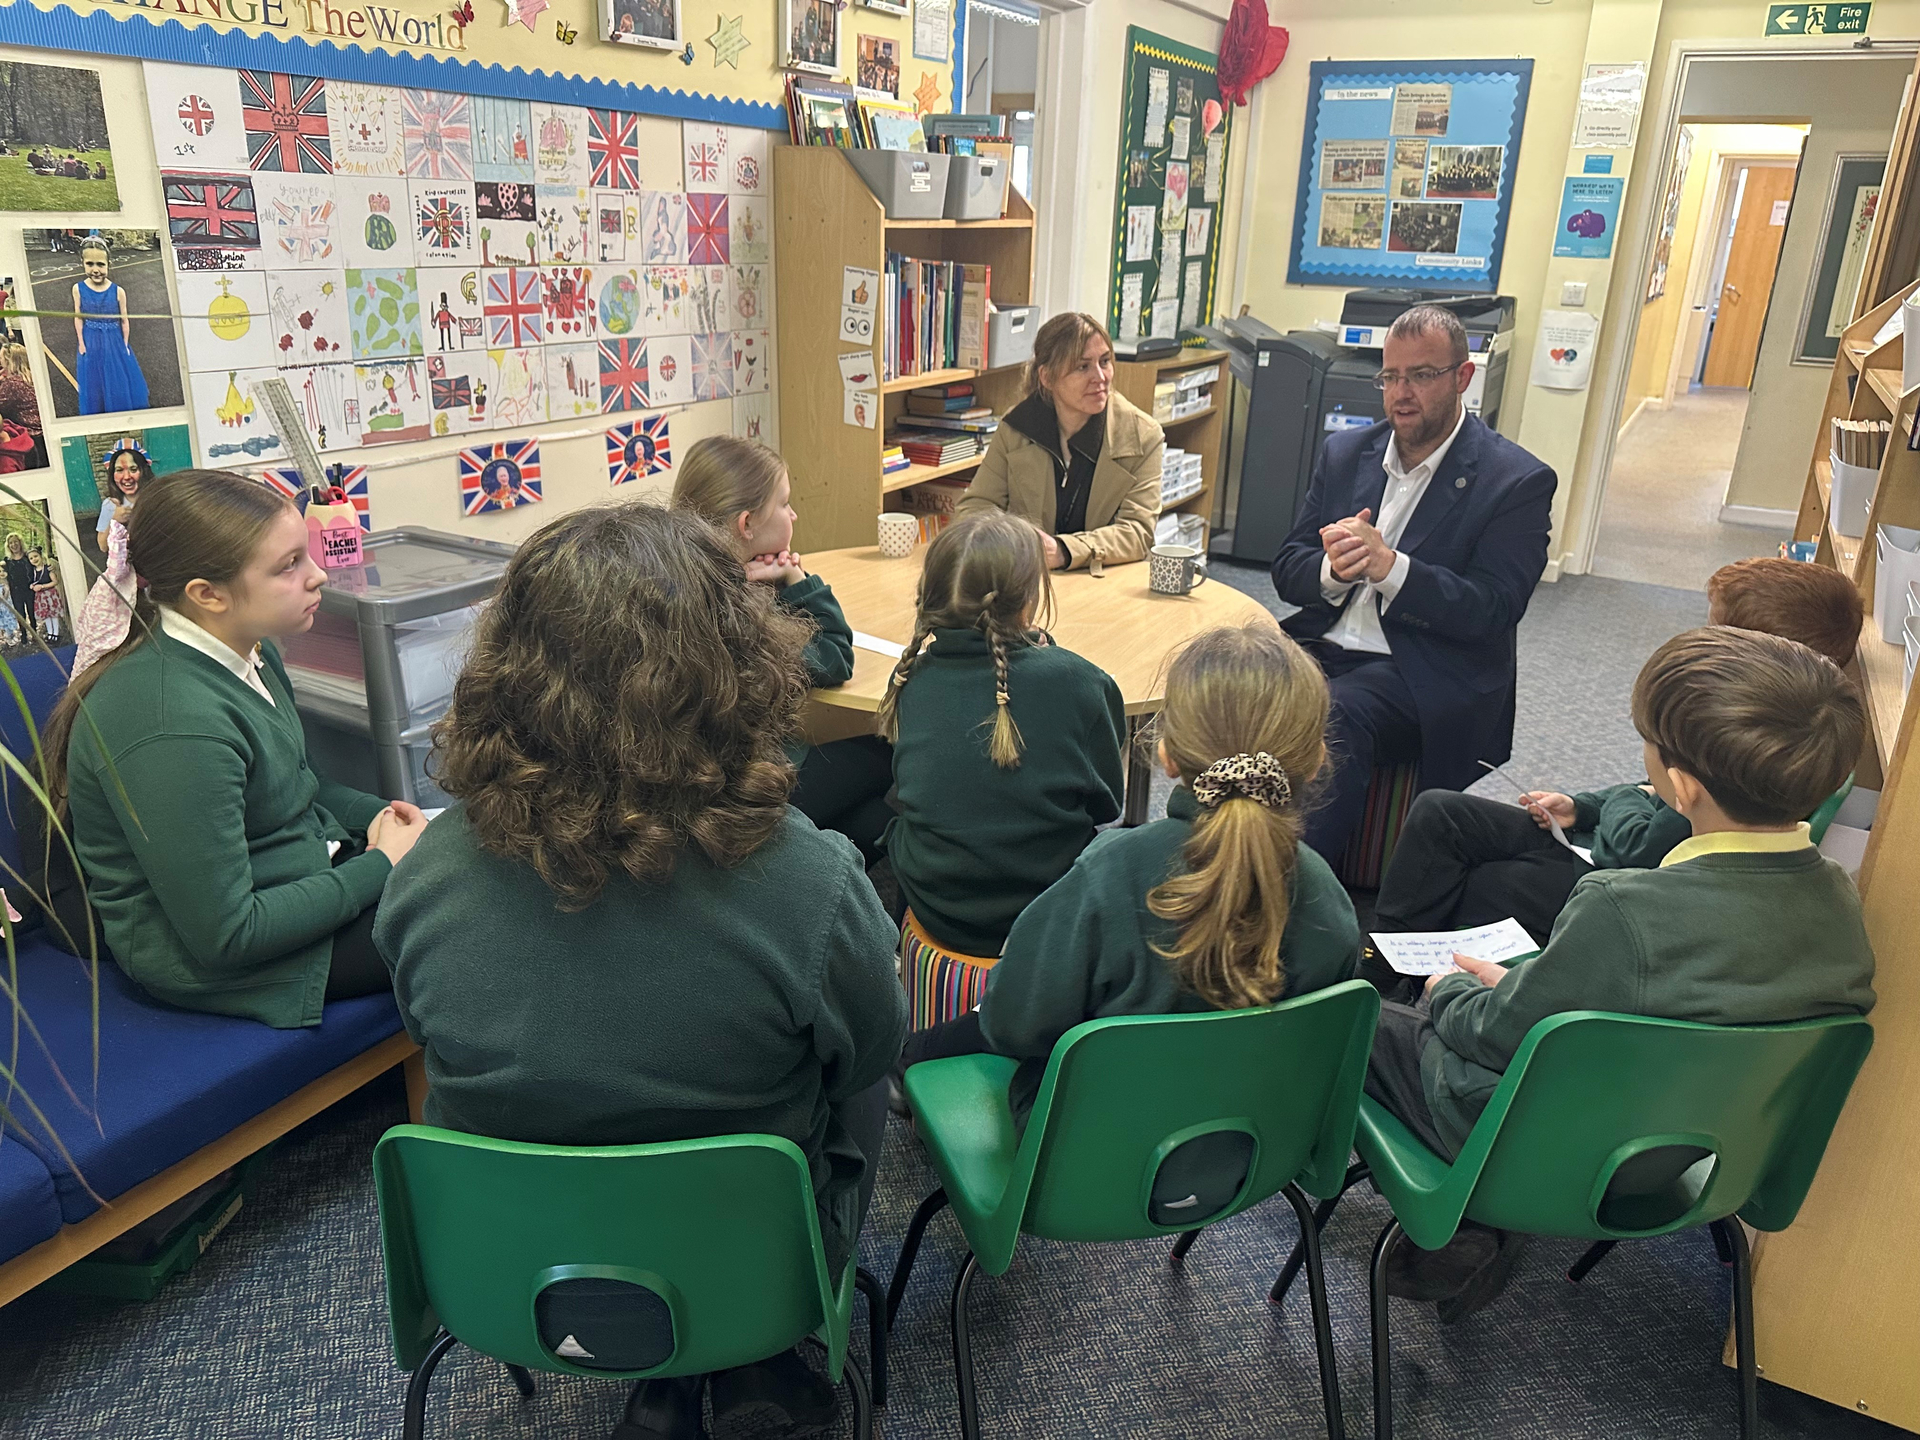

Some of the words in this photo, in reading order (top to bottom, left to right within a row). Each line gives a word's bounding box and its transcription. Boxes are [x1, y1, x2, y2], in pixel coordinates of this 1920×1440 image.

[1840, 7, 1862, 17] Fire
[366, 6, 467, 50] World
[1837, 19, 1860, 29] exit
[1346, 90, 1358, 98] the
[1418, 257, 1460, 267] Community
[1461, 258, 1482, 266] Links
[915, 490, 953, 503] WORLD
[916, 499, 956, 513] ATLAS
